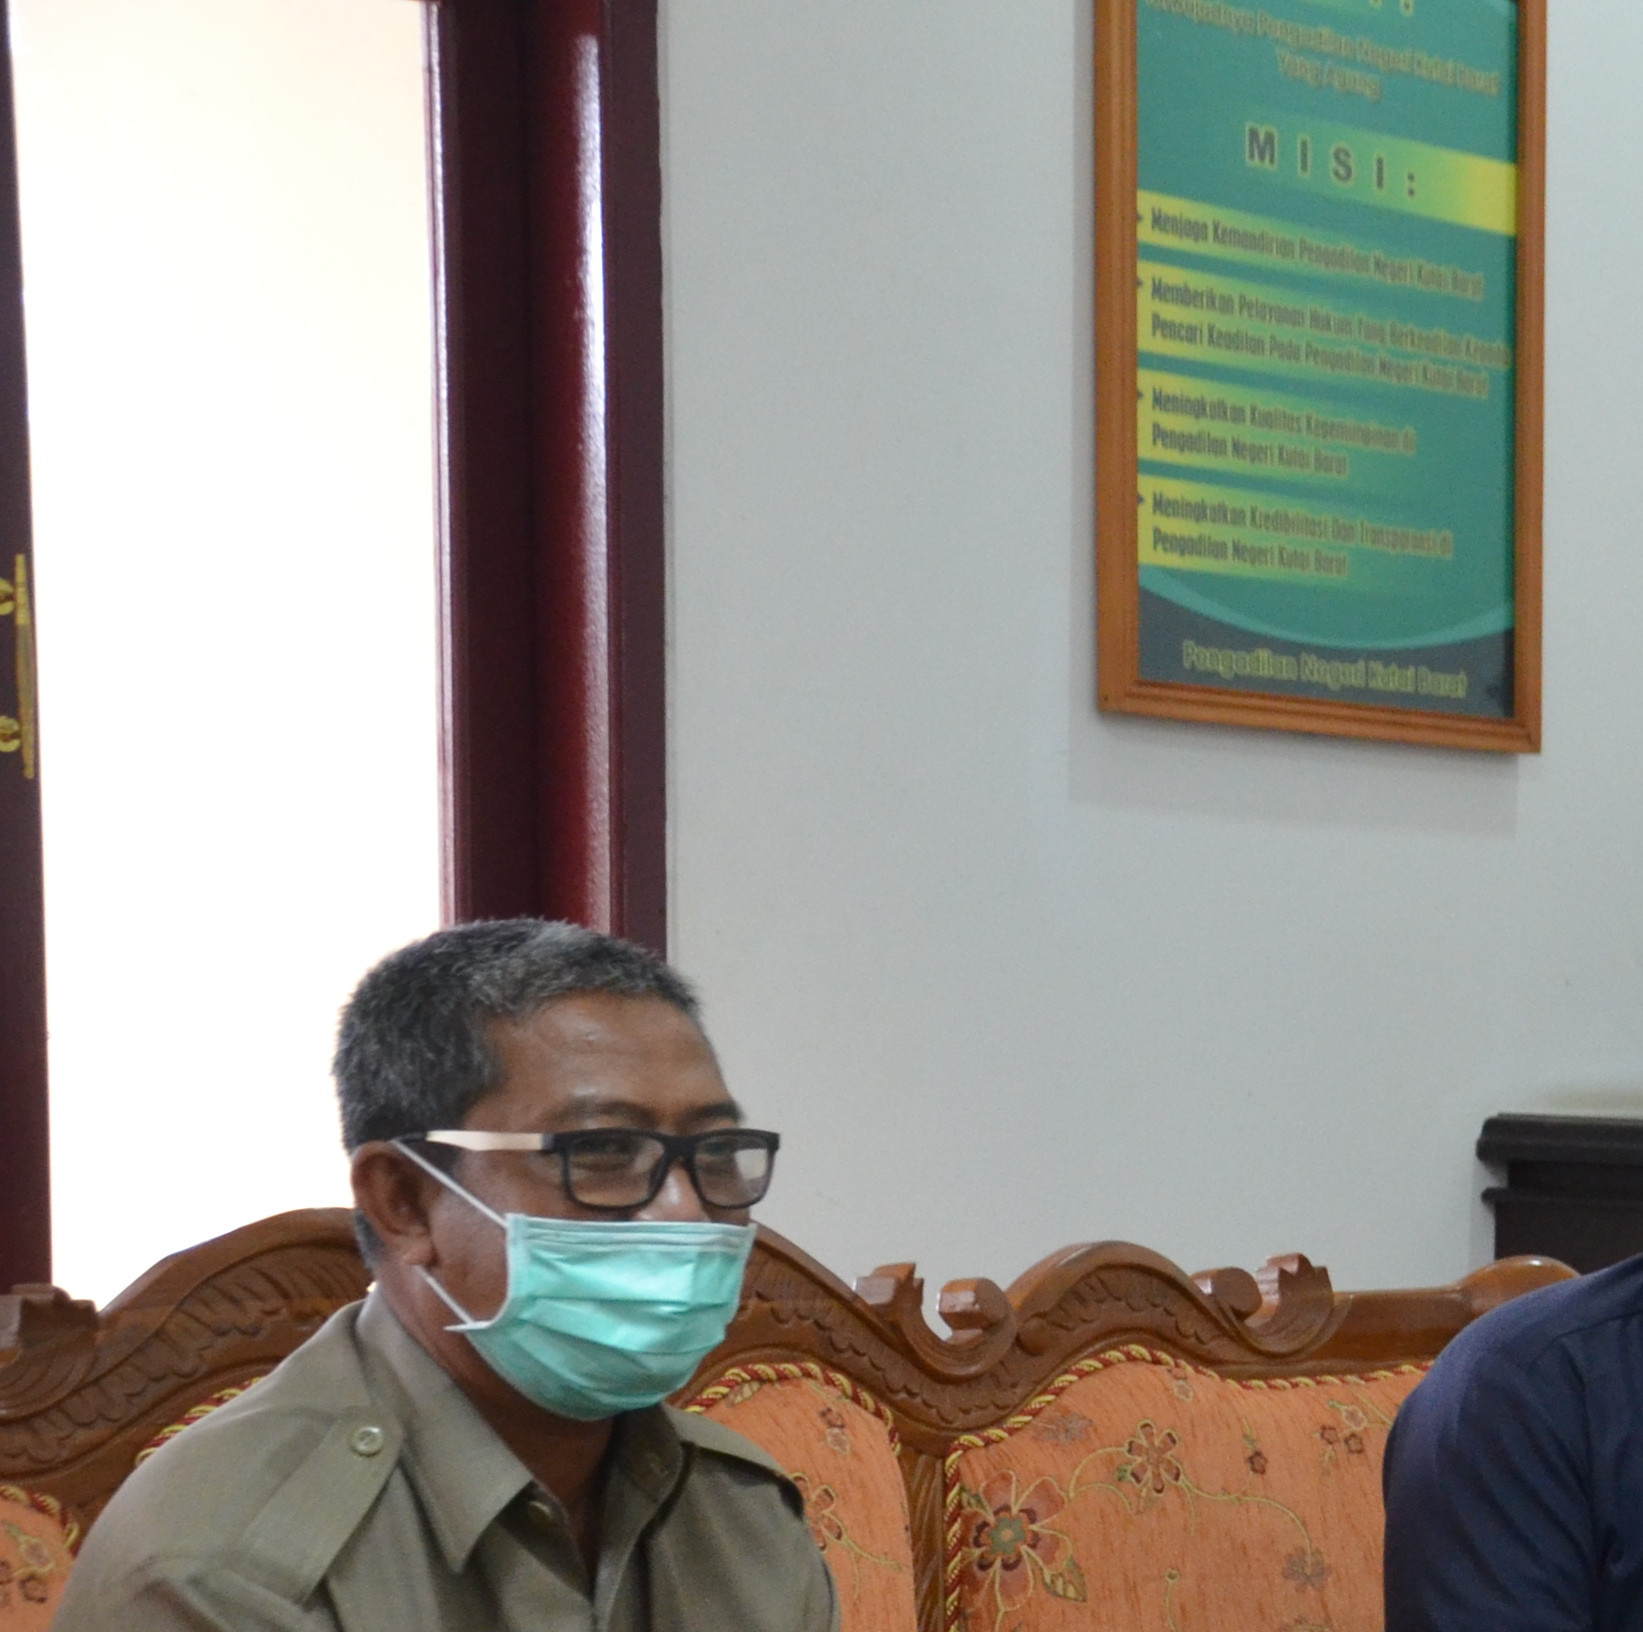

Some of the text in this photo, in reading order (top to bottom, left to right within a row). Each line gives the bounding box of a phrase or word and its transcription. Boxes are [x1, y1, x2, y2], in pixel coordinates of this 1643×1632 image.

[1152, 206, 1208, 243] Menjaga
[1152, 276, 1234, 315] Memberikan
[1152, 312, 1203, 345] Pencari
[1207, 322, 1264, 356] Keadilan
[1152, 386, 1246, 426] Meningkatkan
[1152, 422, 1227, 457] Pengadilan
[1231, 434, 1274, 466] Negeri
[1152, 490, 1246, 528] Meningkatkan
[1152, 525, 1227, 560] Pengadilan
[1231, 537, 1274, 568] Negeri
